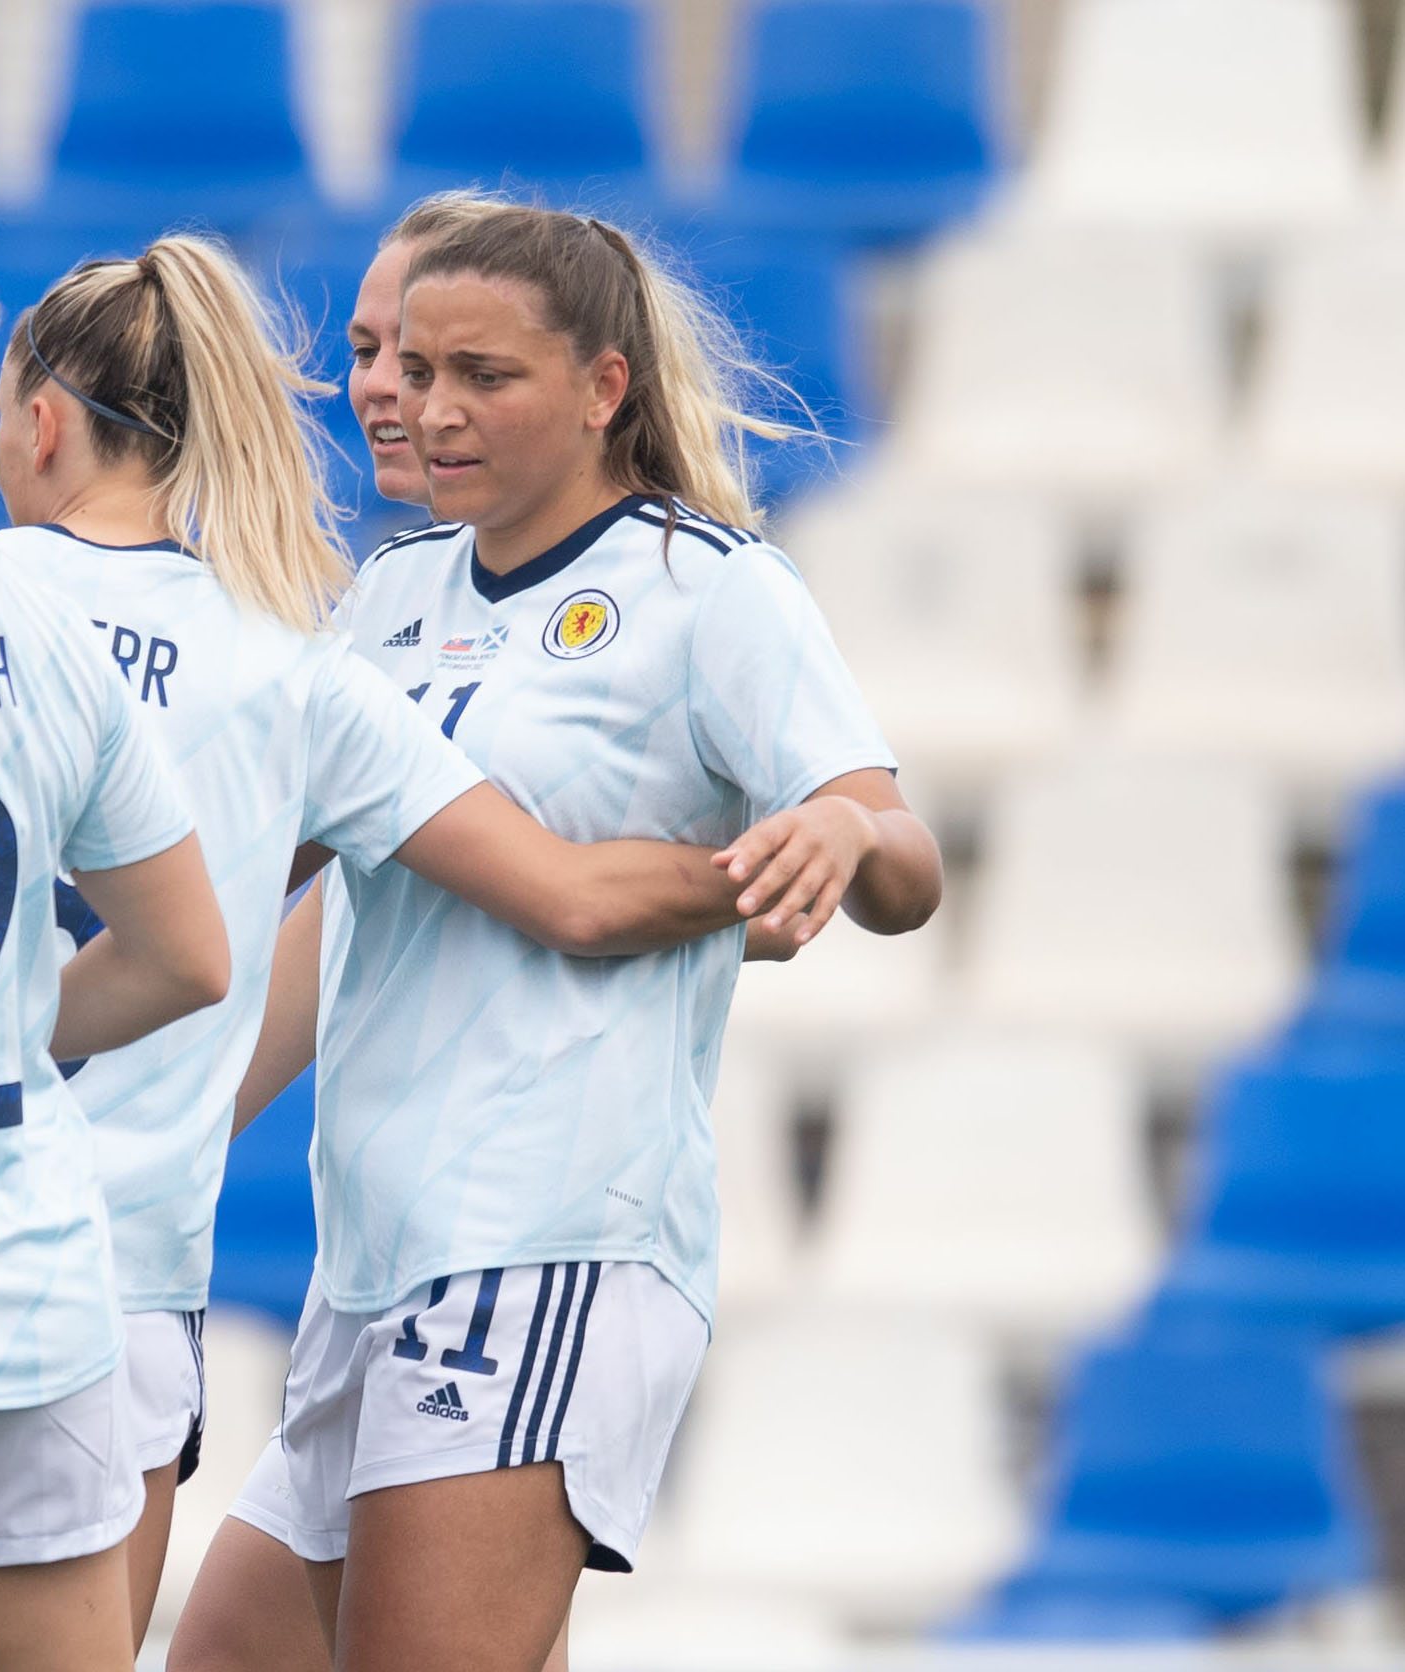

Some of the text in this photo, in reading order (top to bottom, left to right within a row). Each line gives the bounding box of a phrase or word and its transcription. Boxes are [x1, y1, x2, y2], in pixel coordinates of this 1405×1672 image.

[91, 619, 179, 707] RR
[393, 1267, 504, 1376] 11
[416, 1402, 469, 1422] adidas
